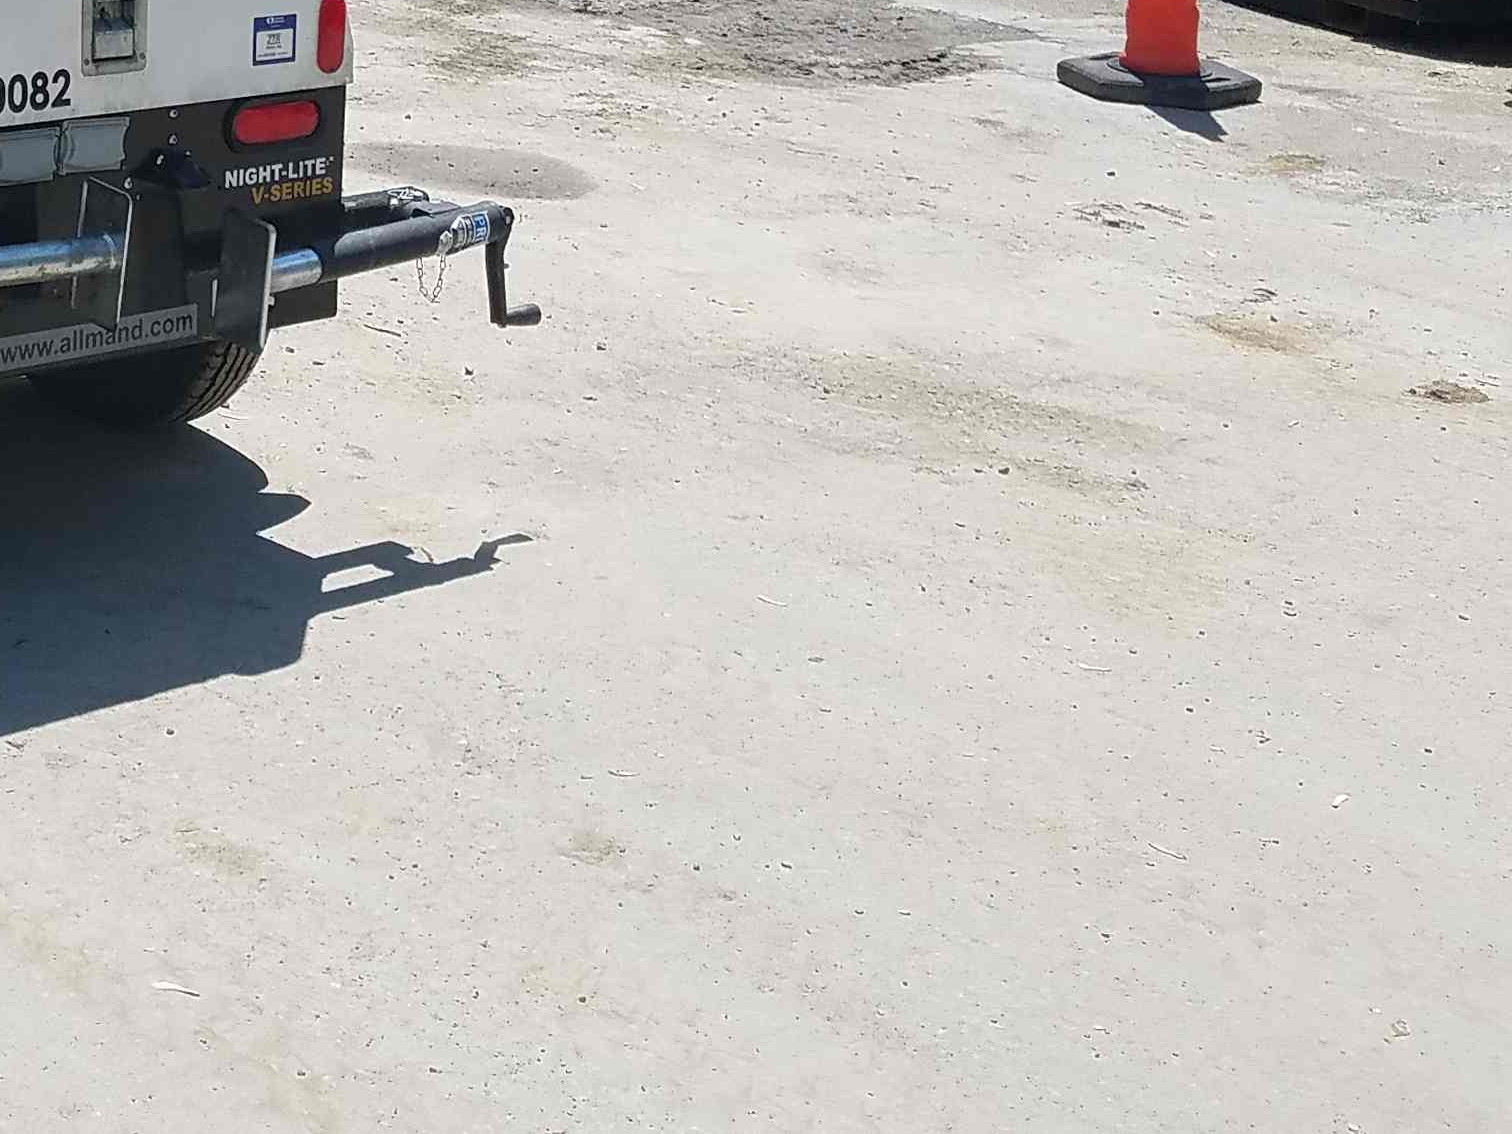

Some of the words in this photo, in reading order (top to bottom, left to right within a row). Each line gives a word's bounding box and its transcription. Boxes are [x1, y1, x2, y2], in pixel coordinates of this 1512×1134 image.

[224, 157, 326, 188] NIGHT-LITE
[252, 177, 333, 204] V-SERIES
[0, 313, 193, 364] www.allmand.com
